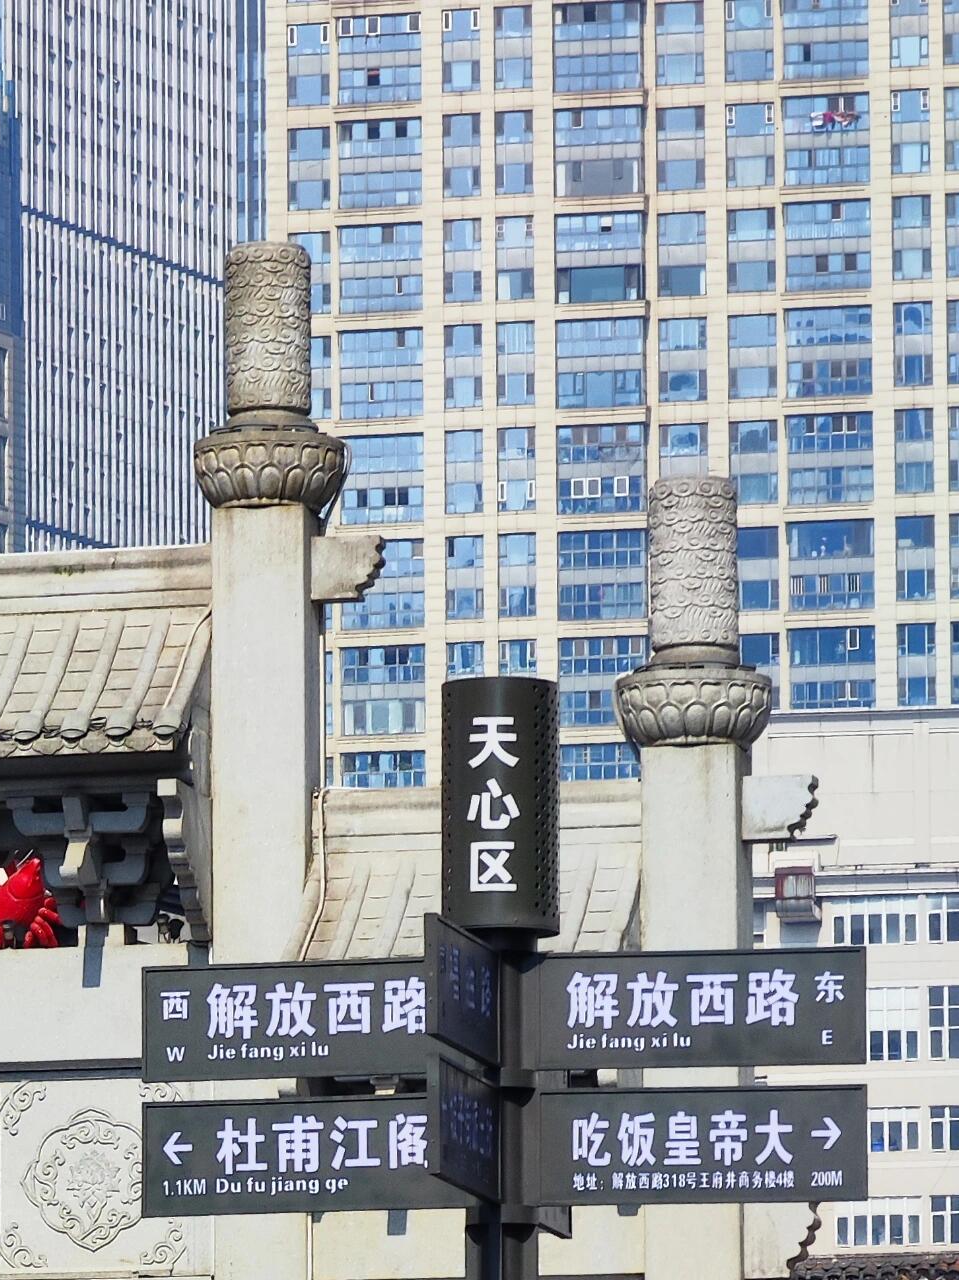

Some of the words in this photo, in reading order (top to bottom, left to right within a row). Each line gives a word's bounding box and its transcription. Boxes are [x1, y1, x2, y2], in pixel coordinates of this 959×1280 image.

[467, 716, 520, 893] 天心区
[566, 967, 800, 1030] 解放西路
[814, 970, 845, 1004] 东
[159, 990, 190, 1020] 西
[206, 975, 427, 1041] 解放西路
[567, 1033, 596, 1050] Jie
[821, 1029, 833, 1046] E
[166, 1046, 185, 1063] W
[207, 1044, 236, 1061] Jie
[240, 1042, 284, 1061] fang
[290, 1041, 307, 1057] xi
[311, 1041, 330, 1057] lu
[215, 1113, 429, 1176] 杜甫江阁
[572, 1108, 793, 1167] 吃饭皇帝大
[163, 1178, 206, 1197] 1.1KM
[215, 1177, 241, 1195] Du
[246, 1176, 266, 1193] fu
[270, 1176, 319, 1196] jiang
[810, 1170, 843, 1188] 200M
